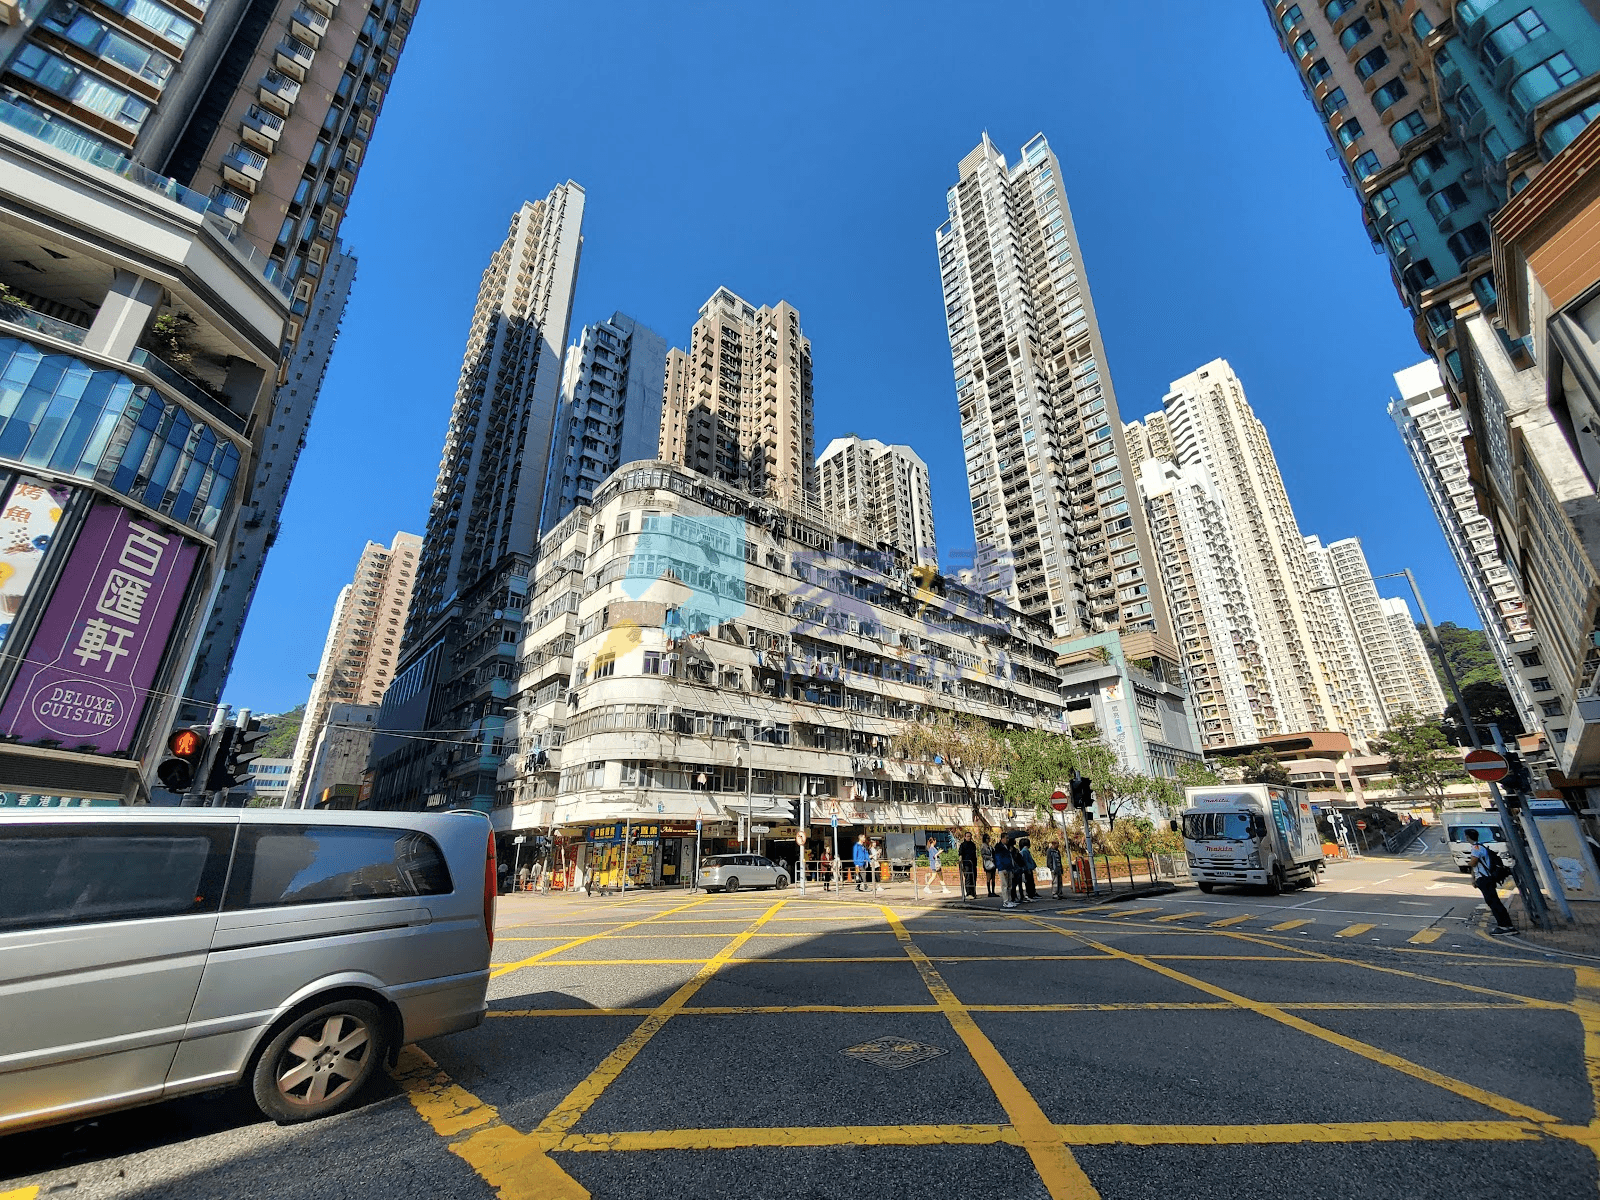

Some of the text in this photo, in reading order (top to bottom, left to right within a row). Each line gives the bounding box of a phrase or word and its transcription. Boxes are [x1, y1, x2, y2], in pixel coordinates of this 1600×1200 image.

[73, 521, 170, 673] 百匯軒
[51, 688, 116, 713] DELUXE
[39, 701, 115, 727] CUISINE
[17, 794, 92, 808] 香港置業
